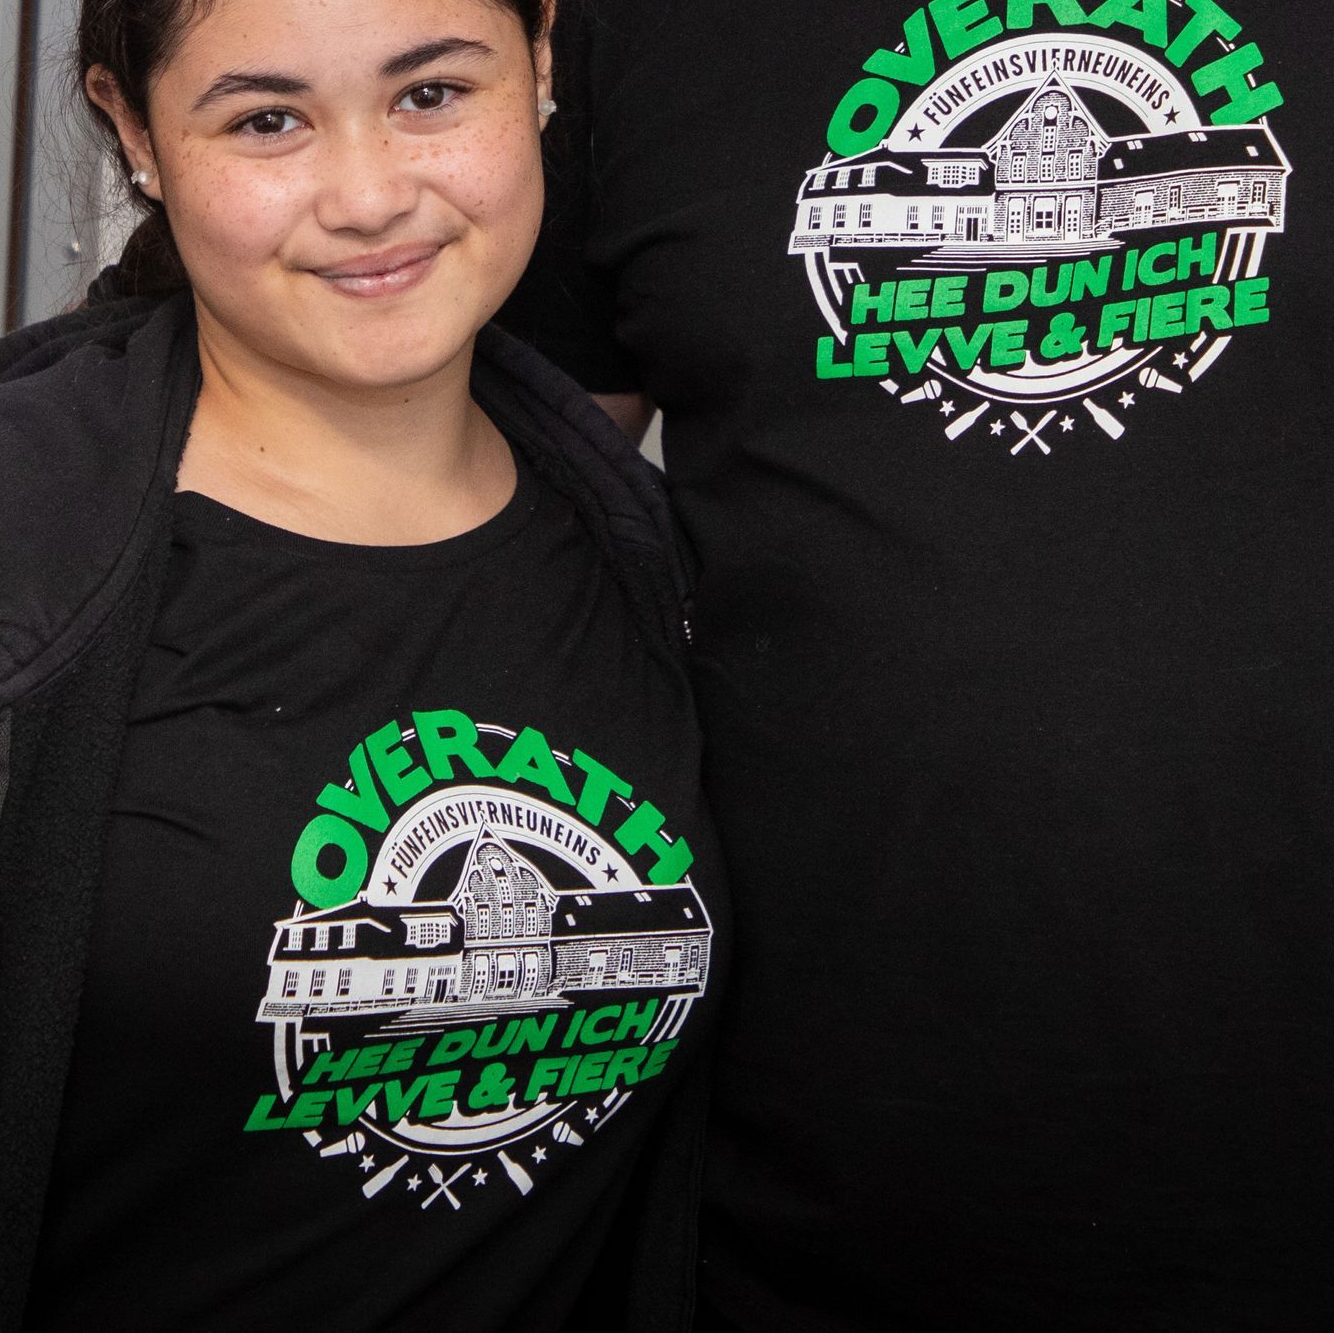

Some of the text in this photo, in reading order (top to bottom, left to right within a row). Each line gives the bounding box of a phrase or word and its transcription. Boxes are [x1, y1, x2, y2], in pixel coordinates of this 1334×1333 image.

[923, 48, 1170, 126] FÜNFEINSVIERNEUNEINS
[851, 232, 1217, 324] HEE DUN ICH
[816, 277, 1270, 379] LEVVE & FIERE
[291, 709, 694, 909] OVERATH
[391, 800, 601, 879] FÜNFEINSVIERNEUNEINS
[243, 1038, 679, 1132] LEVVE & FIERE
[302, 999, 659, 1085] HEE DUN ICH
